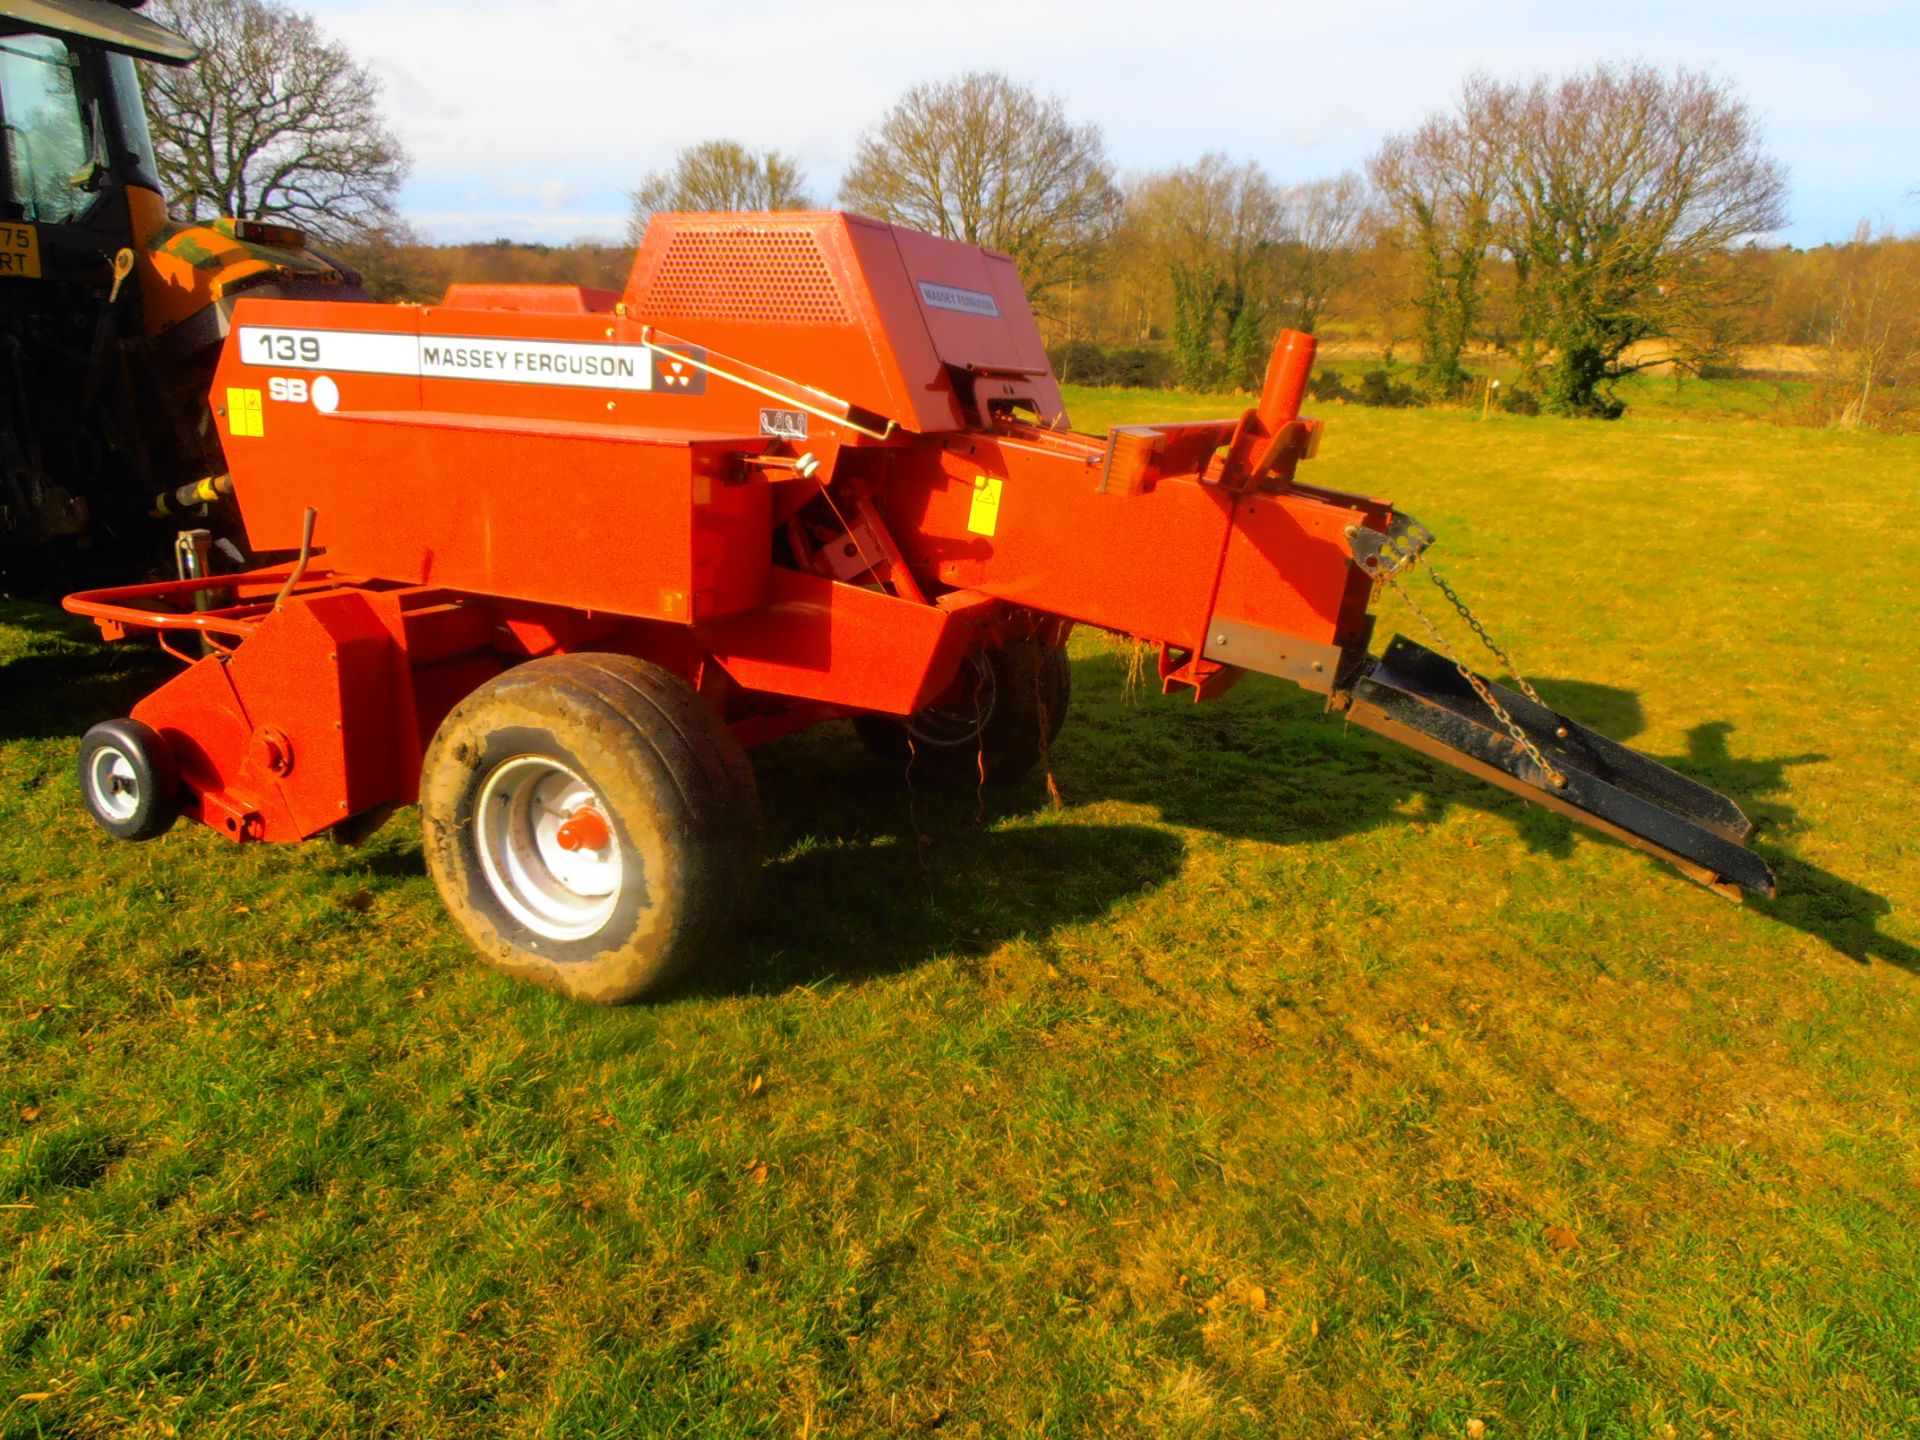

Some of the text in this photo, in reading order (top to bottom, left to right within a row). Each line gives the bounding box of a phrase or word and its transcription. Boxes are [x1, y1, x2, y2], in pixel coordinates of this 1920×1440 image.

[0, 227, 30, 248] 75
[0, 251, 28, 272] RT
[259, 334, 321, 363] 139
[423, 347, 634, 377] MASSEY FERGUSON
[268, 376, 309, 404] SB
